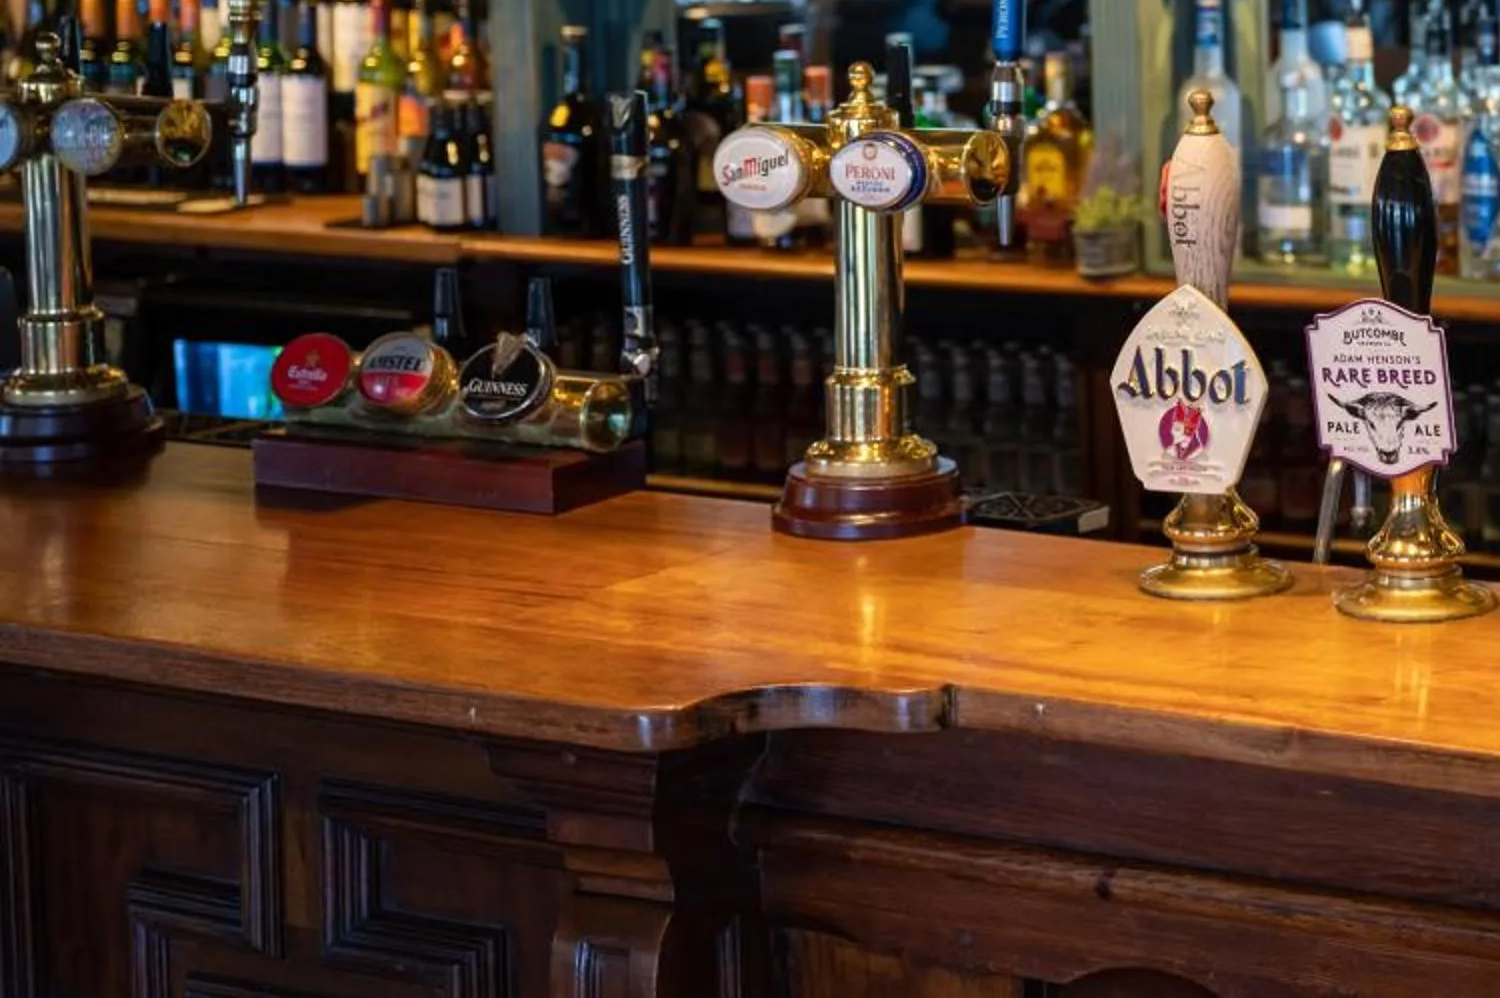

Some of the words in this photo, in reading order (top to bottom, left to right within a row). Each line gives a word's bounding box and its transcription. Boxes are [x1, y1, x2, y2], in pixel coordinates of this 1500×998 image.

[845, 162, 896, 180] PERONI
[617, 193, 634, 266] GUINNESS
[1342, 327, 1408, 347] BUTCOMBE
[1332, 354, 1363, 363] ADAM
[1366, 355, 1422, 366] HENSON'S
[1117, 345, 1250, 405] Abbot
[1321, 367, 1372, 389] RARE
[1376, 369, 1437, 390] BREED
[469, 377, 529, 397] GUINNESS
[1327, 421, 1361, 434] PALE
[1414, 424, 1442, 438] ALE
